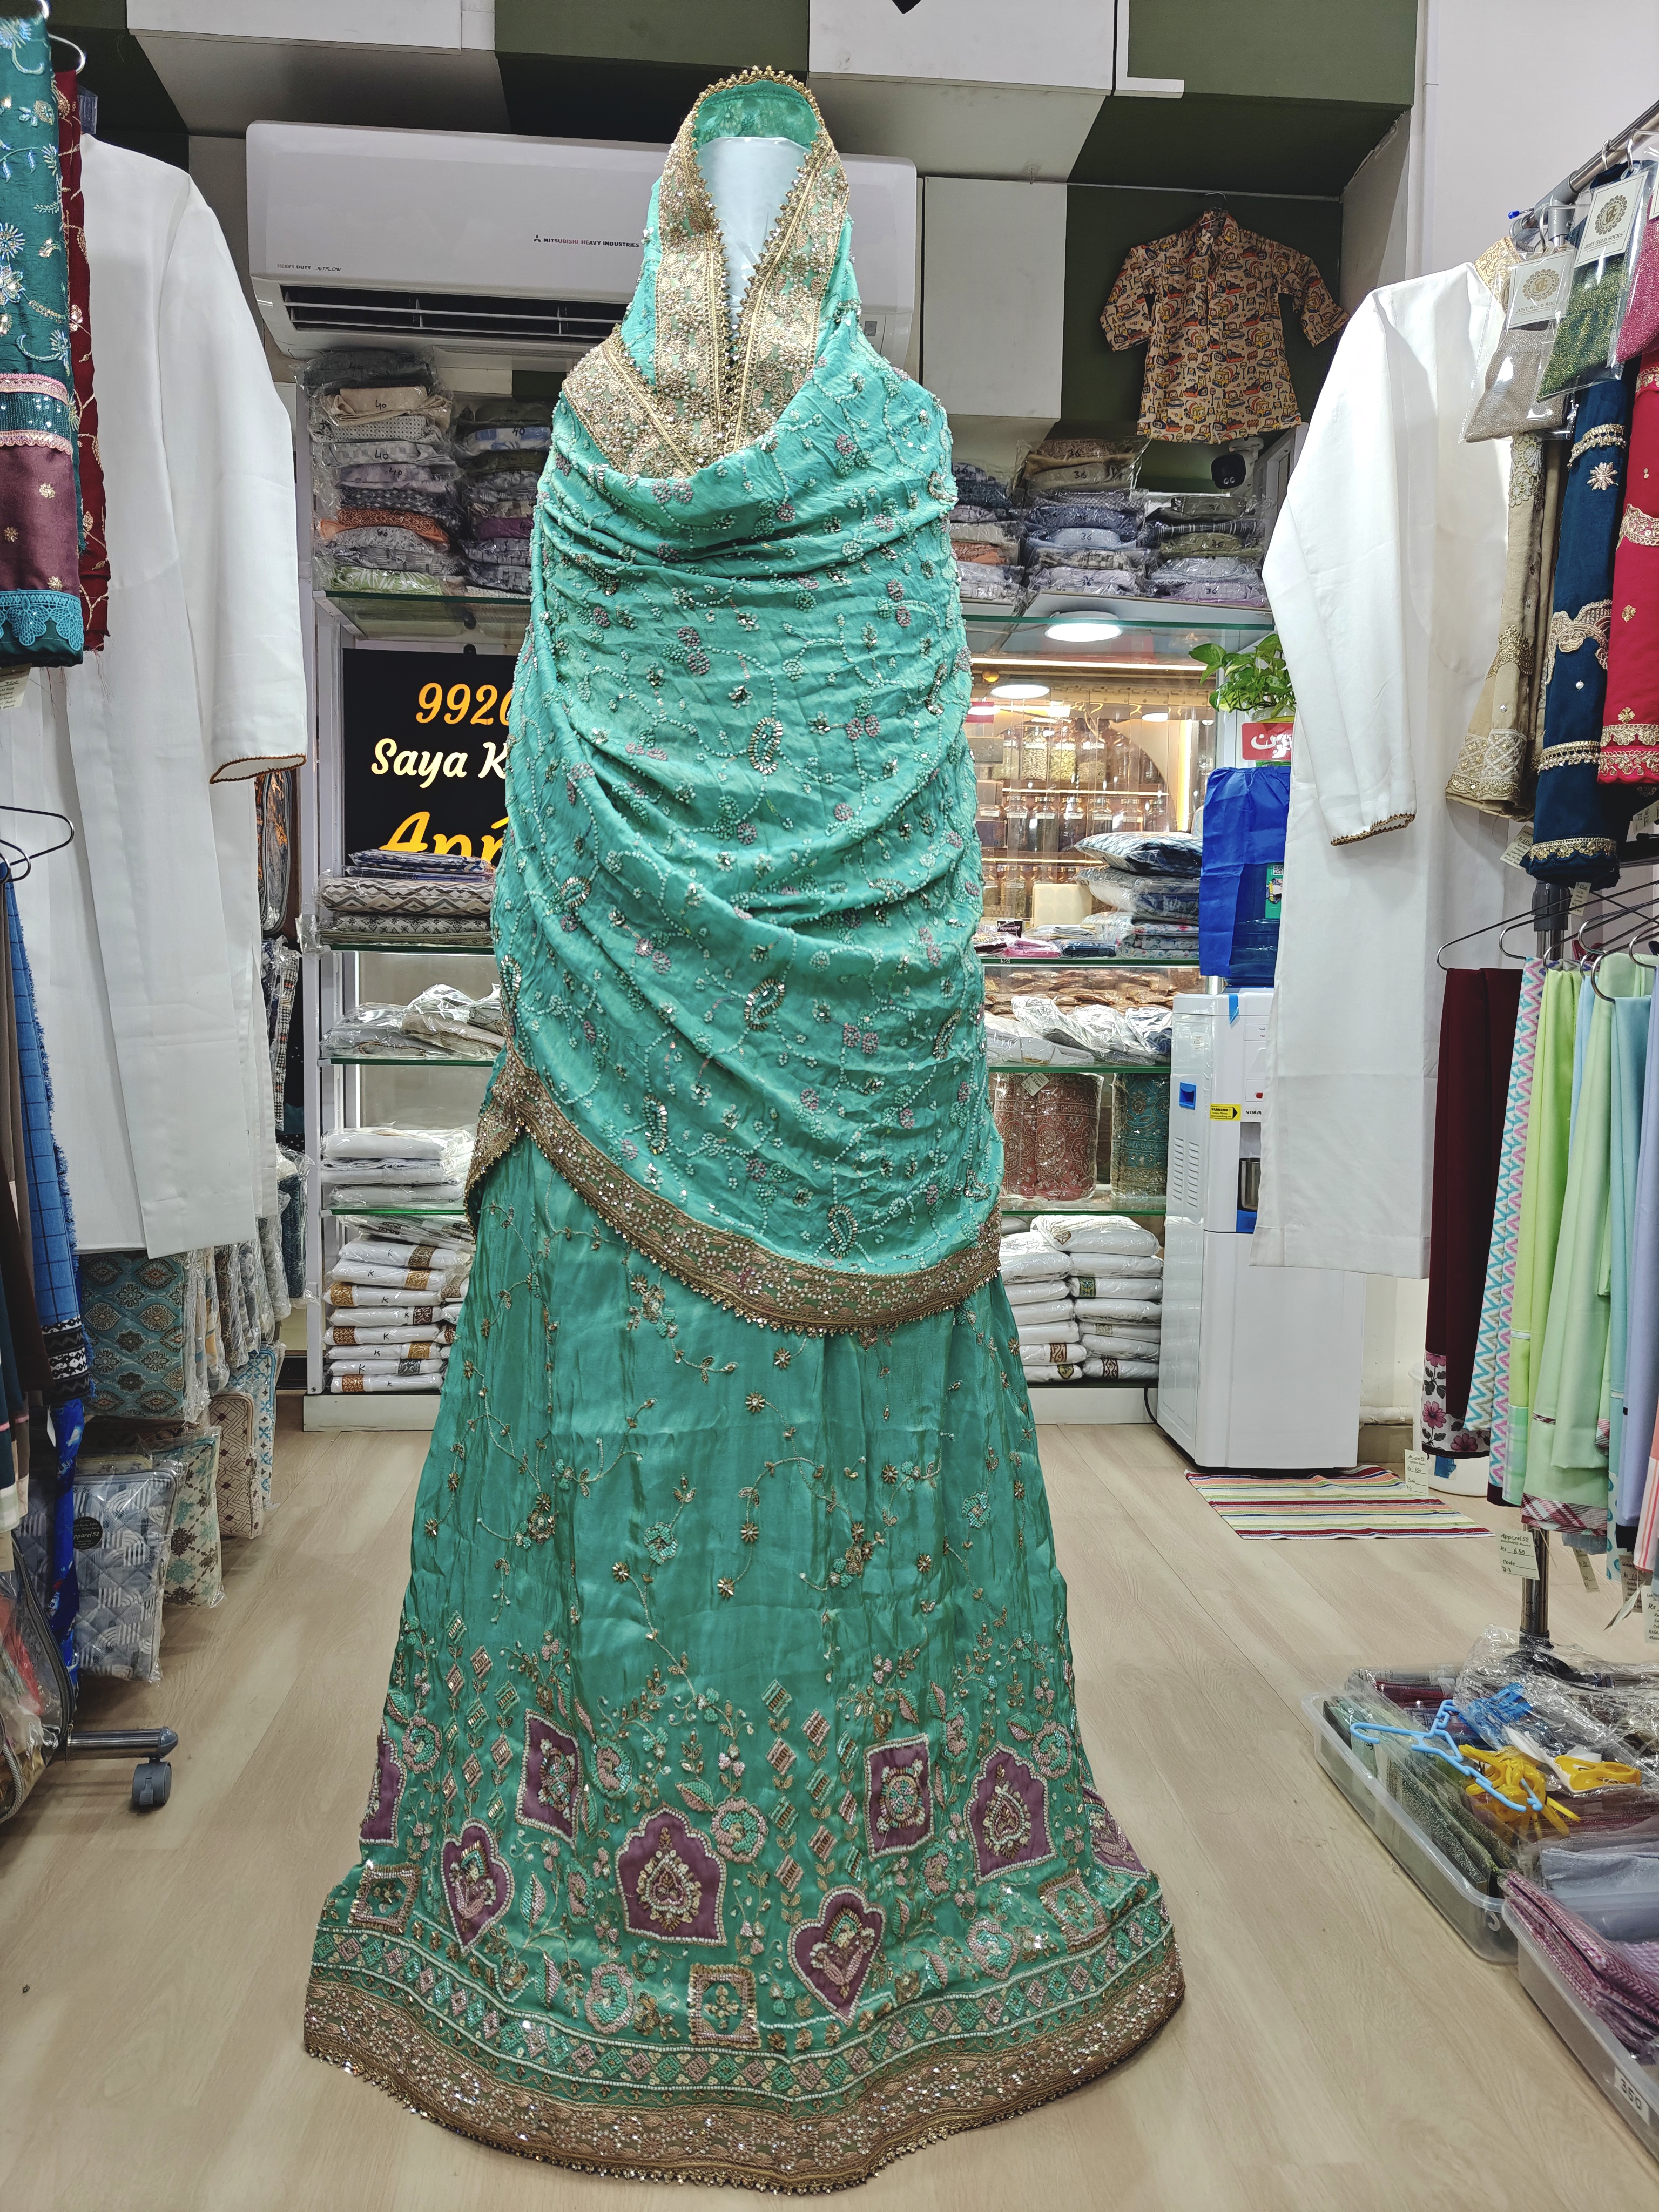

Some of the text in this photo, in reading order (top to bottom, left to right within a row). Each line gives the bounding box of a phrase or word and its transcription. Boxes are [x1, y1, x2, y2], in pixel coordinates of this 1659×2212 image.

[375, 400, 387, 411] 40
[375, 449, 389, 460] 40
[388, 467, 403, 476] 40
[1073, 470, 1087, 480] 36
[1080, 532, 1092, 541] 36
[1205, 586, 1219, 595] 36
[370, 738, 468, 788] Saya
[368, 1269, 375, 1277] K
[383, 1332, 389, 1340] K
[359, 1364, 367, 1374] K
[73, 1531, 92, 1540] pparel
[1621, 2078, 1642, 2110] 350
